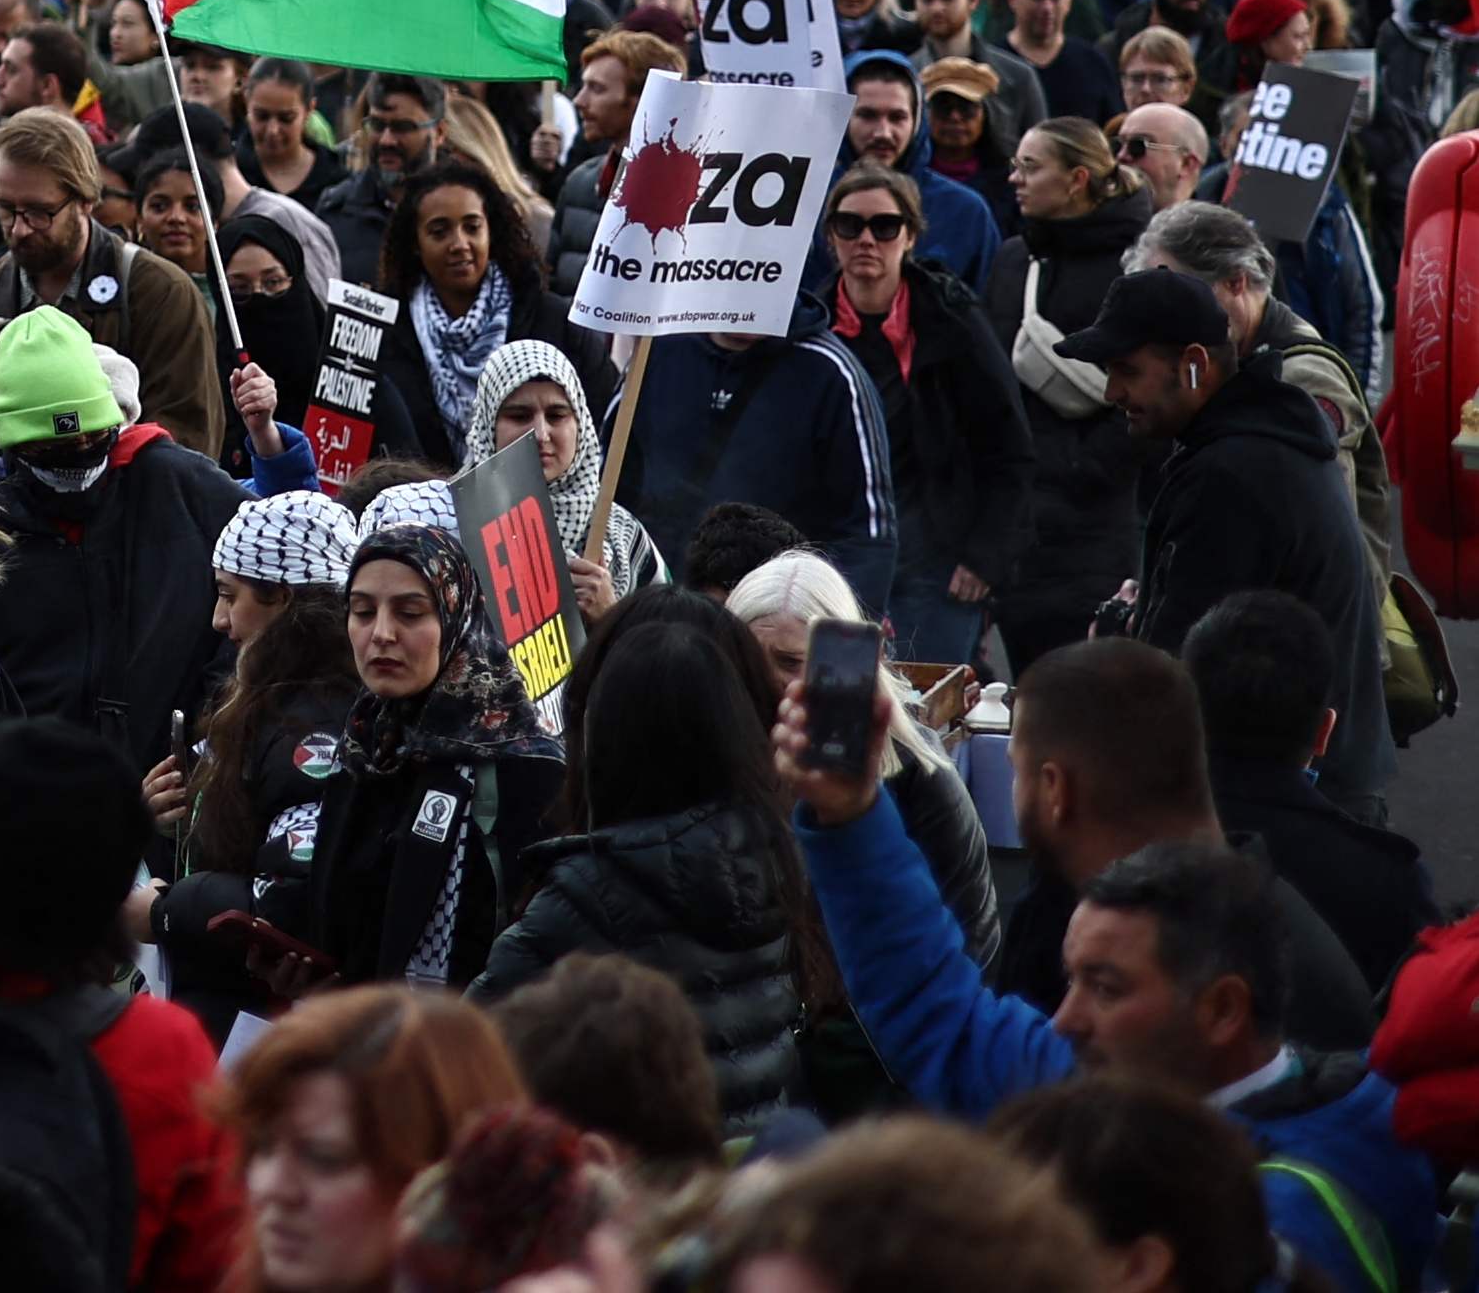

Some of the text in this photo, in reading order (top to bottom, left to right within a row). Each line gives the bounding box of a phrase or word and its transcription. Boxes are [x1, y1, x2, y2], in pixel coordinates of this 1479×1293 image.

[689, 152, 810, 228] za
[592, 242, 783, 285] the massacre
[330, 314, 384, 361] FREEDOM
[594, 306, 756, 325] Coalition www.stopwar.org.uk
[315, 364, 376, 415] PALESTINE
[480, 494, 560, 641] END
